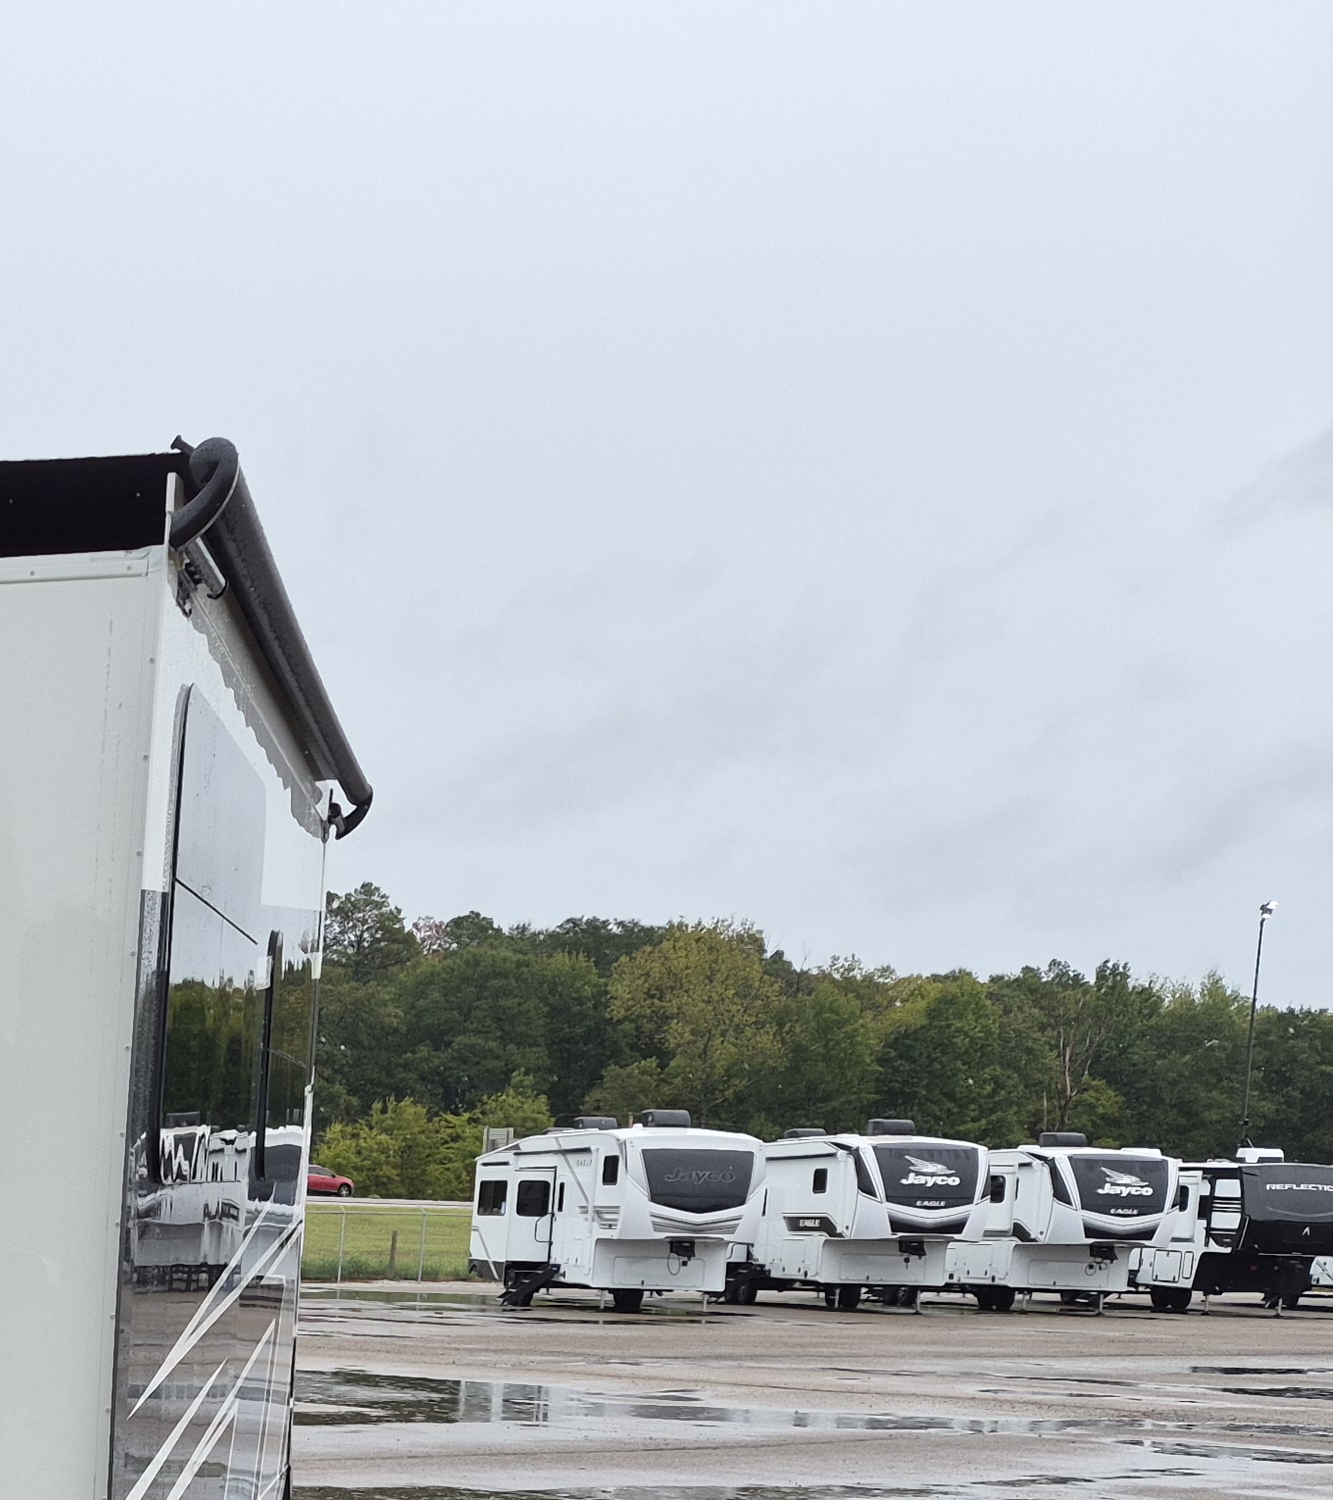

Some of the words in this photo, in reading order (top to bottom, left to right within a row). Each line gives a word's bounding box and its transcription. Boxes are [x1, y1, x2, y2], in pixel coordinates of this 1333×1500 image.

[665, 1167, 736, 1185] Jayco
[900, 1172, 961, 1187] Jayco
[1097, 1182, 1153, 1197] Jayco
[799, 1219, 821, 1227] EAGLE
